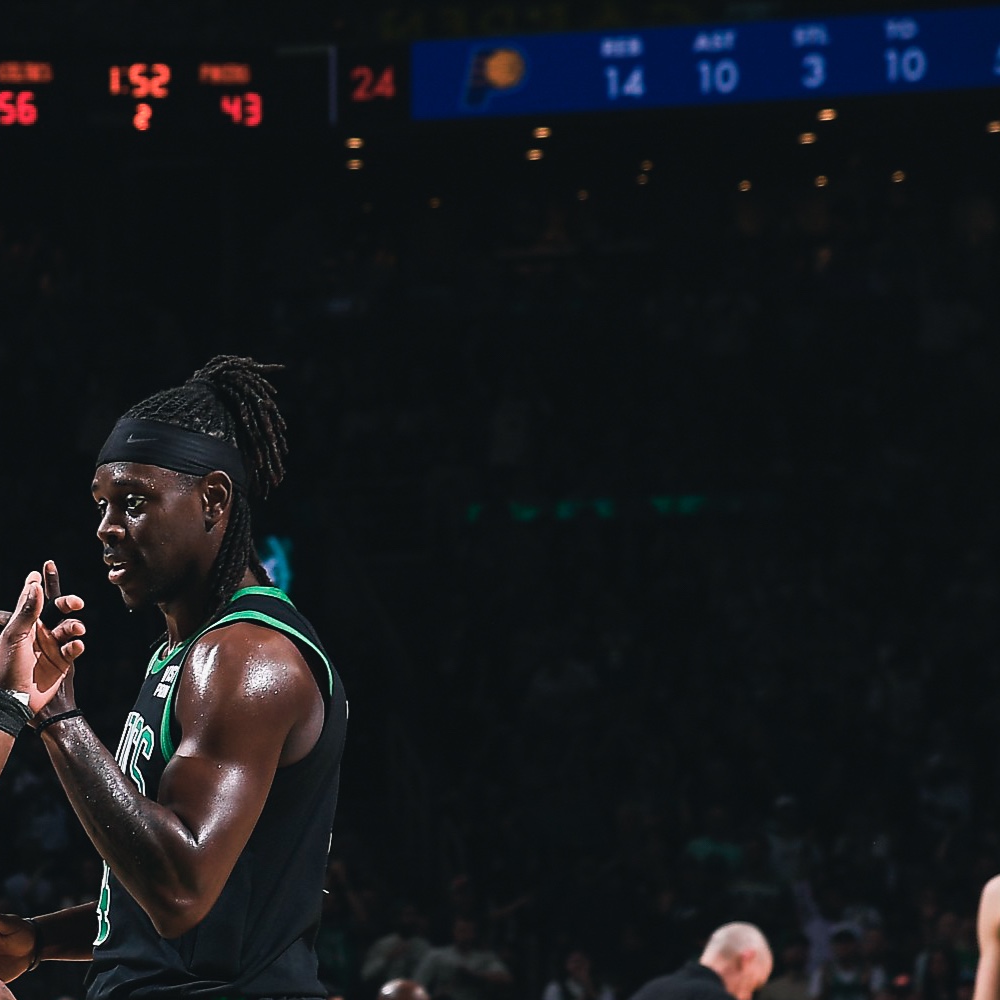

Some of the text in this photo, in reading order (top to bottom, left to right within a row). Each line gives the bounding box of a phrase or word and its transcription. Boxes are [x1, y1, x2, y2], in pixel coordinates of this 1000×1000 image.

[605, 65, 645, 99] 14
[698, 59, 739, 95] 10
[803, 53, 826, 88] 3
[885, 47, 926, 83] 10
[350, 65, 395, 101] 24
[221, 92, 262, 127] 43
